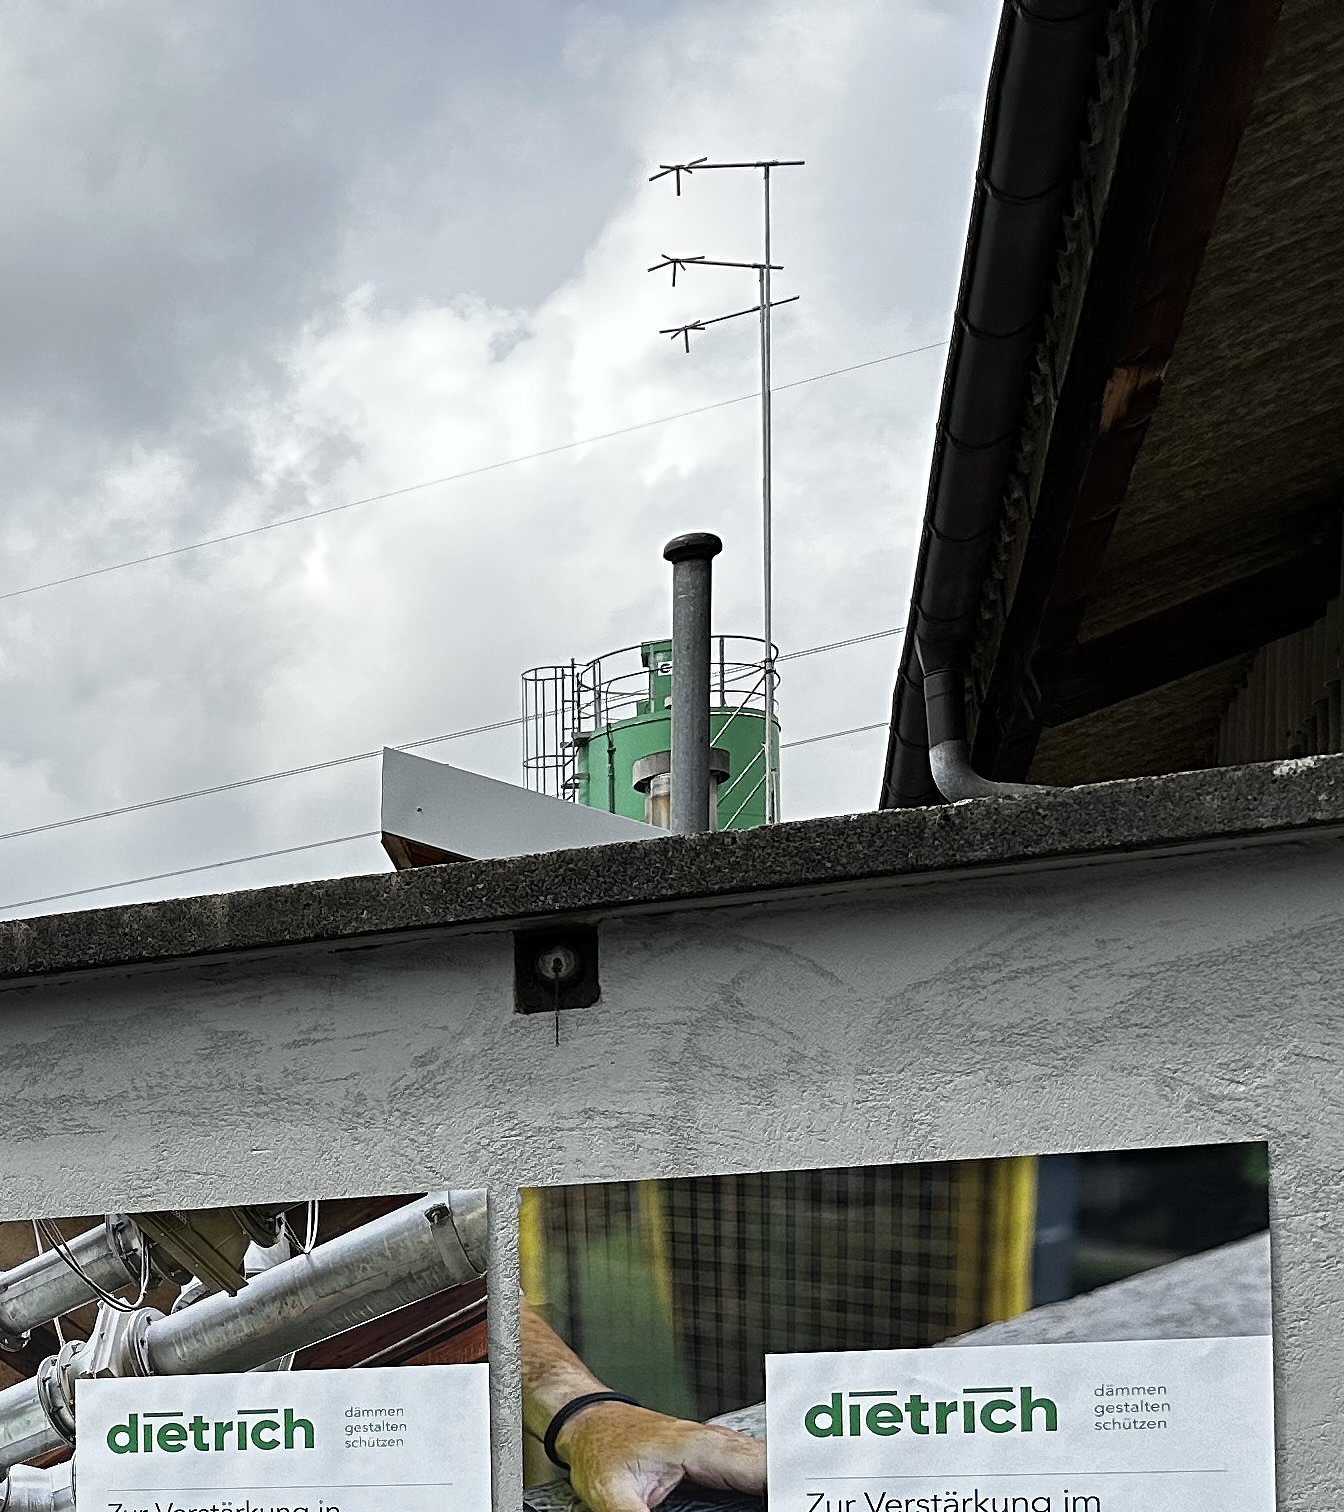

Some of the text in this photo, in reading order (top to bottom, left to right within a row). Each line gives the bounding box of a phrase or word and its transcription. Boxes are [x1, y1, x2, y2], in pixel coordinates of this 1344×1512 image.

[1093, 1383, 1167, 1397] dämmen
[344, 1405, 404, 1418] dämmen
[804, 1386, 1058, 1439] dietrich
[1093, 1399, 1171, 1417] gestalten
[106, 1407, 315, 1455] dietrich
[344, 1419, 407, 1436] gestalten
[1094, 1417, 1168, 1431] schützen
[344, 1435, 404, 1449] schützen
